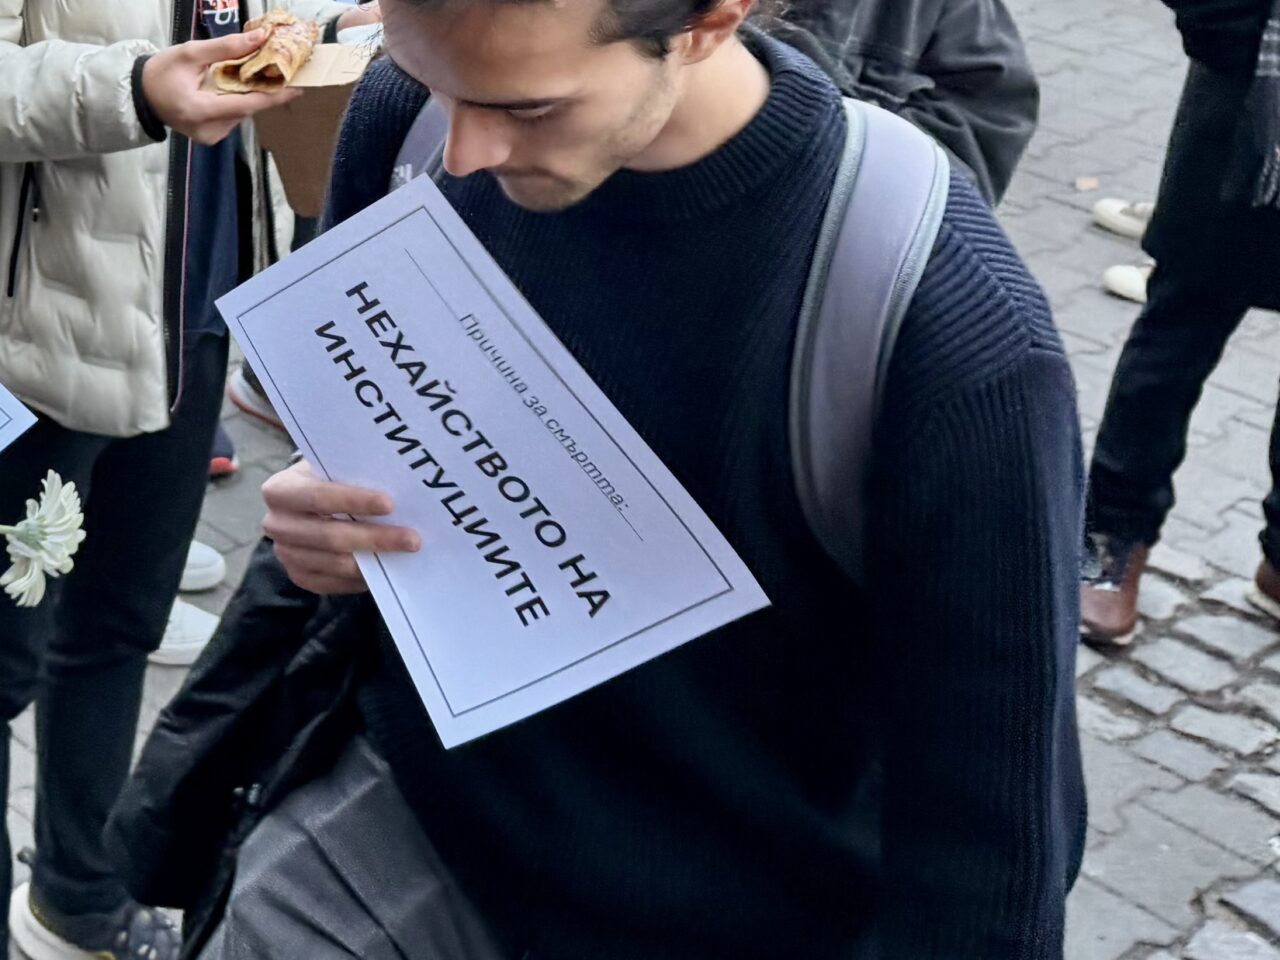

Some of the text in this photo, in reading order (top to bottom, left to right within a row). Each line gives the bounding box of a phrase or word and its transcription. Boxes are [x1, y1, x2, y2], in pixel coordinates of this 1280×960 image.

[314, 320, 551, 628] ИНСТИТУЦИИТЕ
[345, 281, 612, 619] НЕХАЙСТВОТО НА
[459, 312, 631, 513] Причина за смъртта:
